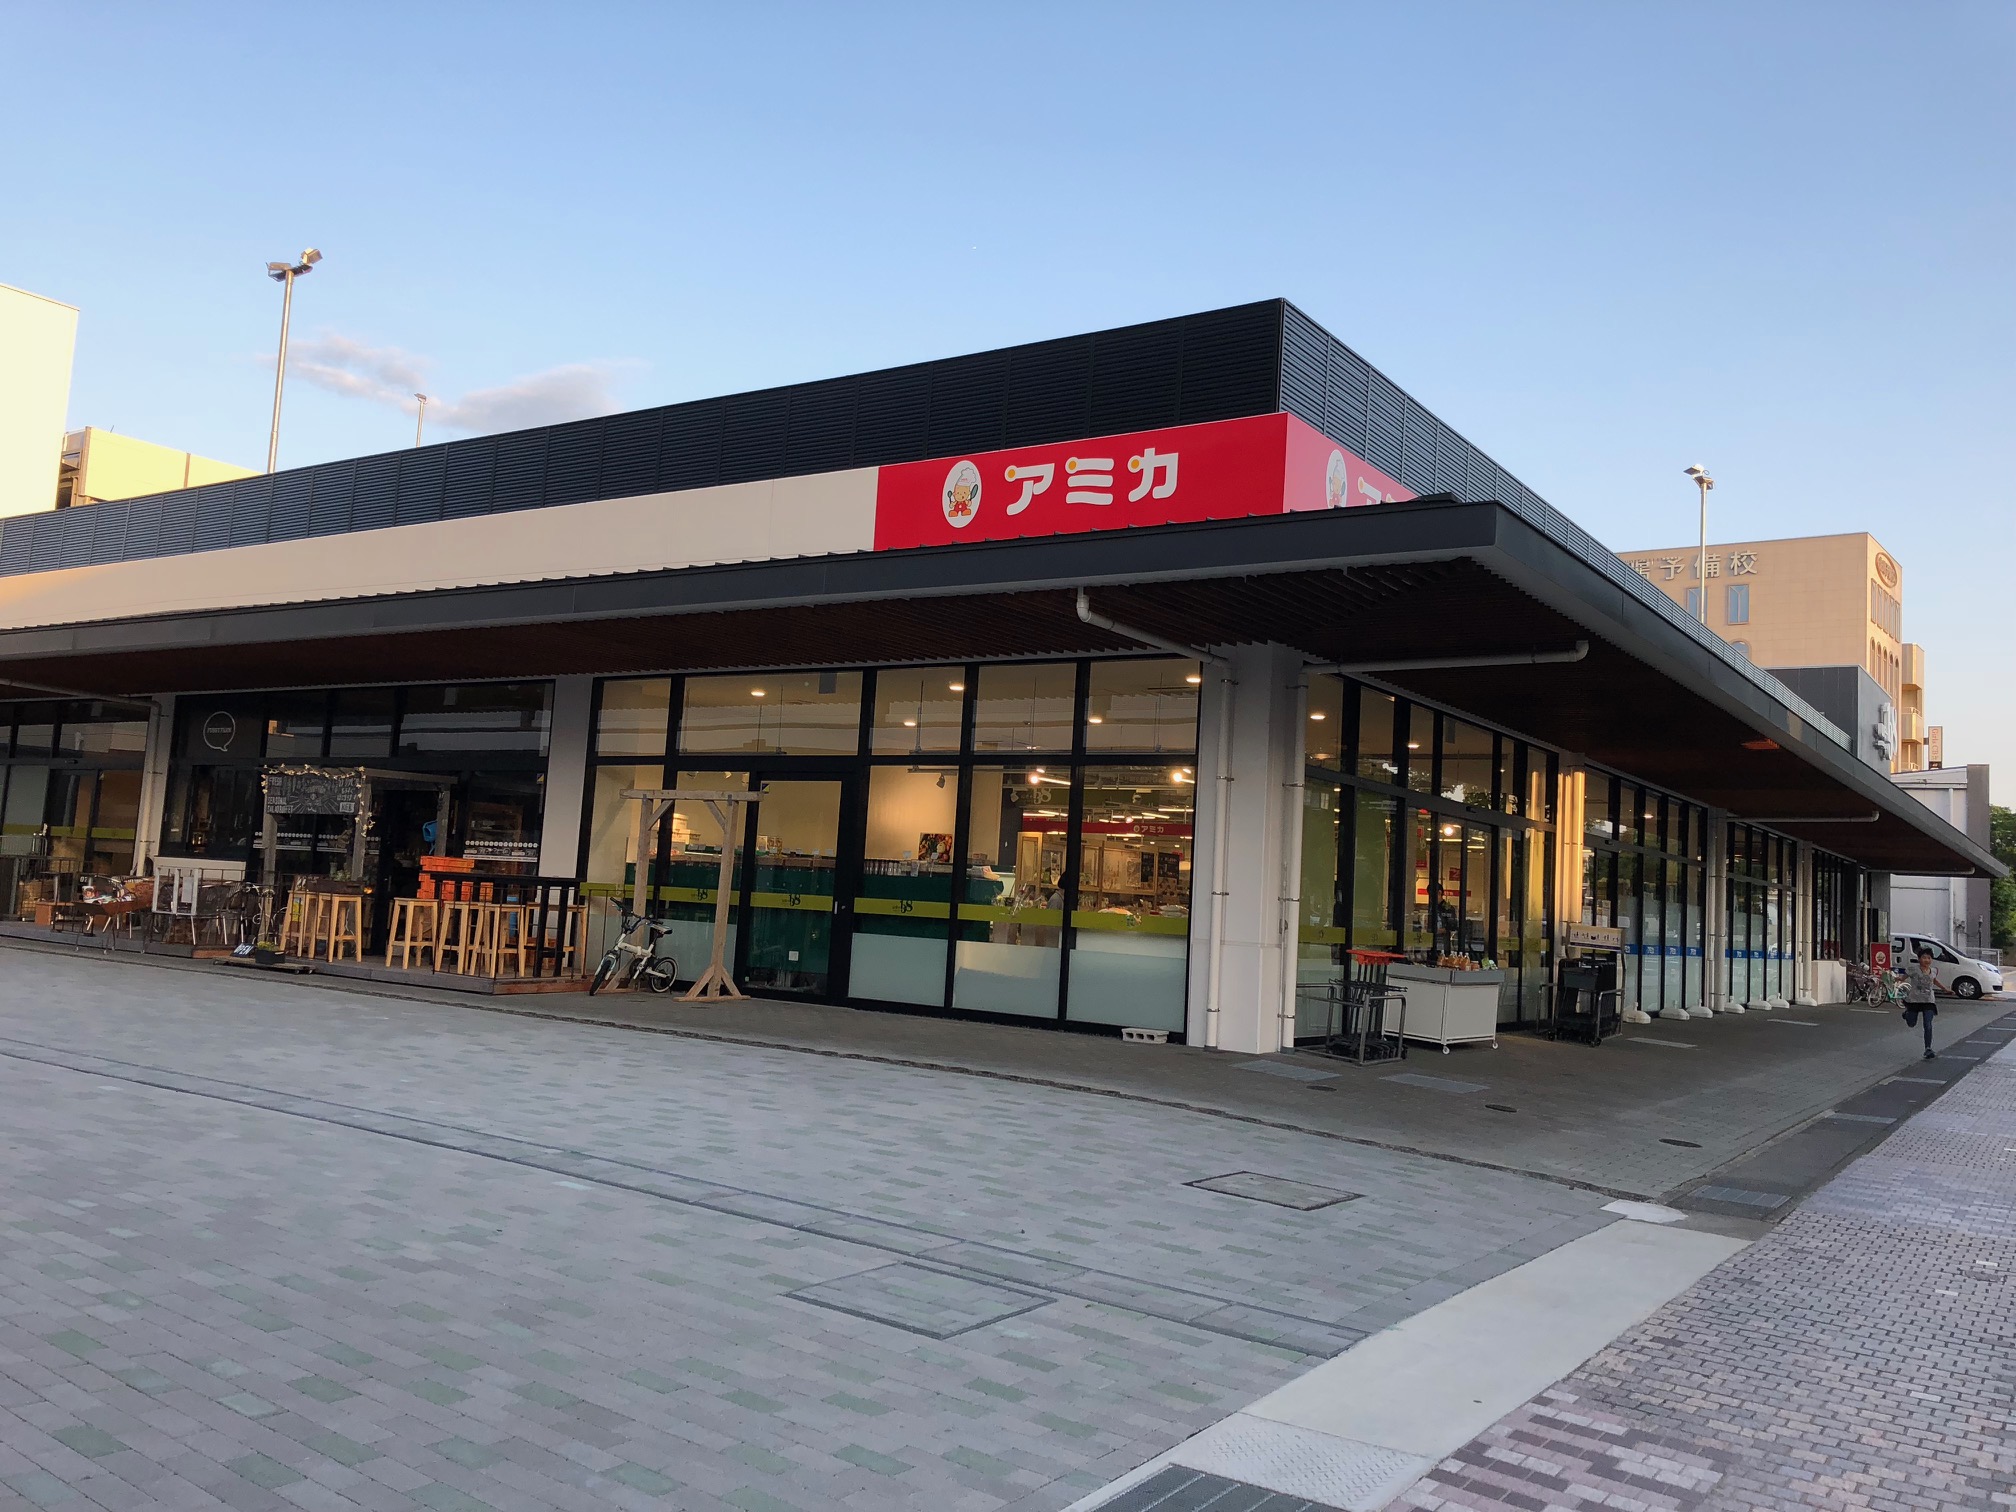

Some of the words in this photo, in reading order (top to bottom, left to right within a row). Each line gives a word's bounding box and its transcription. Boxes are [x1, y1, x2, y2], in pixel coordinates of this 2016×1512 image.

[1004, 447, 1179, 516] アミカ
[1141, 825, 1164, 833] アミカ
